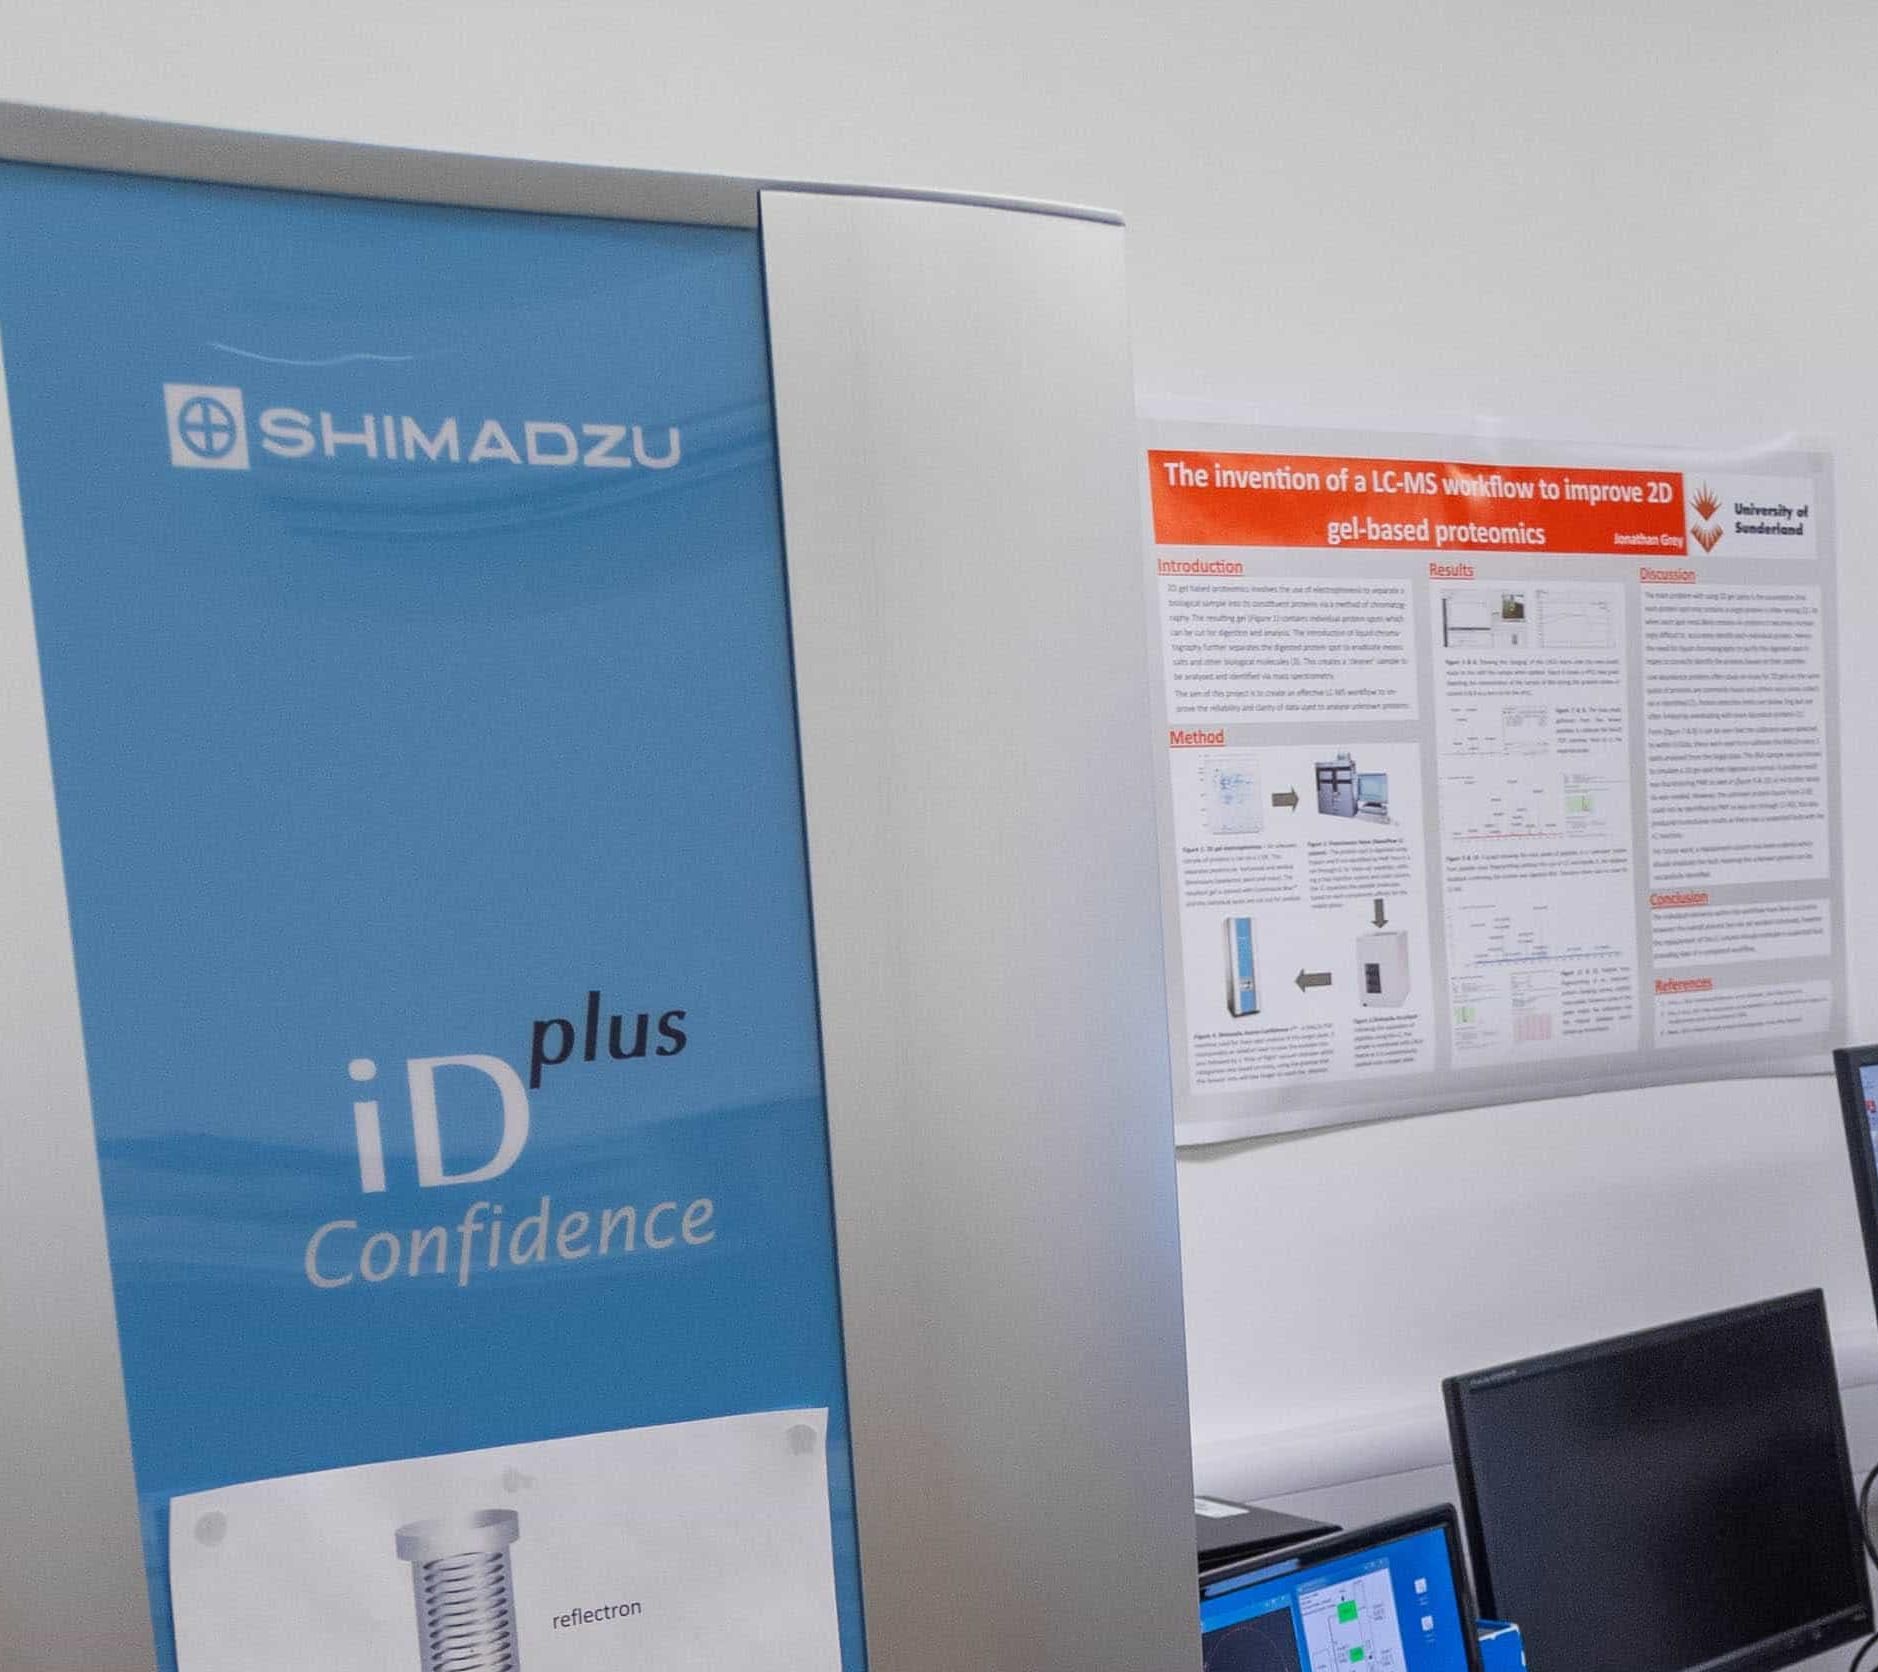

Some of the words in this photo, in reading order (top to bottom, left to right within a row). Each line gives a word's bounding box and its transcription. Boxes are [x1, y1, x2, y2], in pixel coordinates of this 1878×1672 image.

[258, 407, 682, 470] SHIMADZU
[1163, 461, 1209, 488] The
[1214, 463, 1321, 491] invention
[1325, 466, 1349, 492] of
[1353, 475, 1368, 493] a
[1372, 470, 1437, 495] LC-MS
[1442, 473, 1535, 500] workflow
[1538, 478, 1561, 501] to
[1564, 477, 1644, 506] improve
[1647, 481, 1674, 504] 2D
[1734, 502, 1793, 520] University
[1796, 504, 1809, 518] of
[1327, 515, 1430, 545] gel-based
[1435, 521, 1546, 547] proteomics
[1734, 521, 1804, 536] Sunderland
[1613, 532, 1659, 546] Jonathan
[1660, 534, 1685, 548] Grey
[1157, 558, 1243, 574] Introduction
[1429, 562, 1475, 578] Results
[1639, 567, 1697, 581] Discussion
[1169, 730, 1225, 745] Method
[1650, 893, 1708, 907] Conclusion
[1654, 977, 1713, 993] References
[347, 1053, 530, 1194] iD
[529, 989, 689, 1090] plus
[304, 1195, 717, 1289] Confidence
[552, 1600, 643, 1630] reflectron
